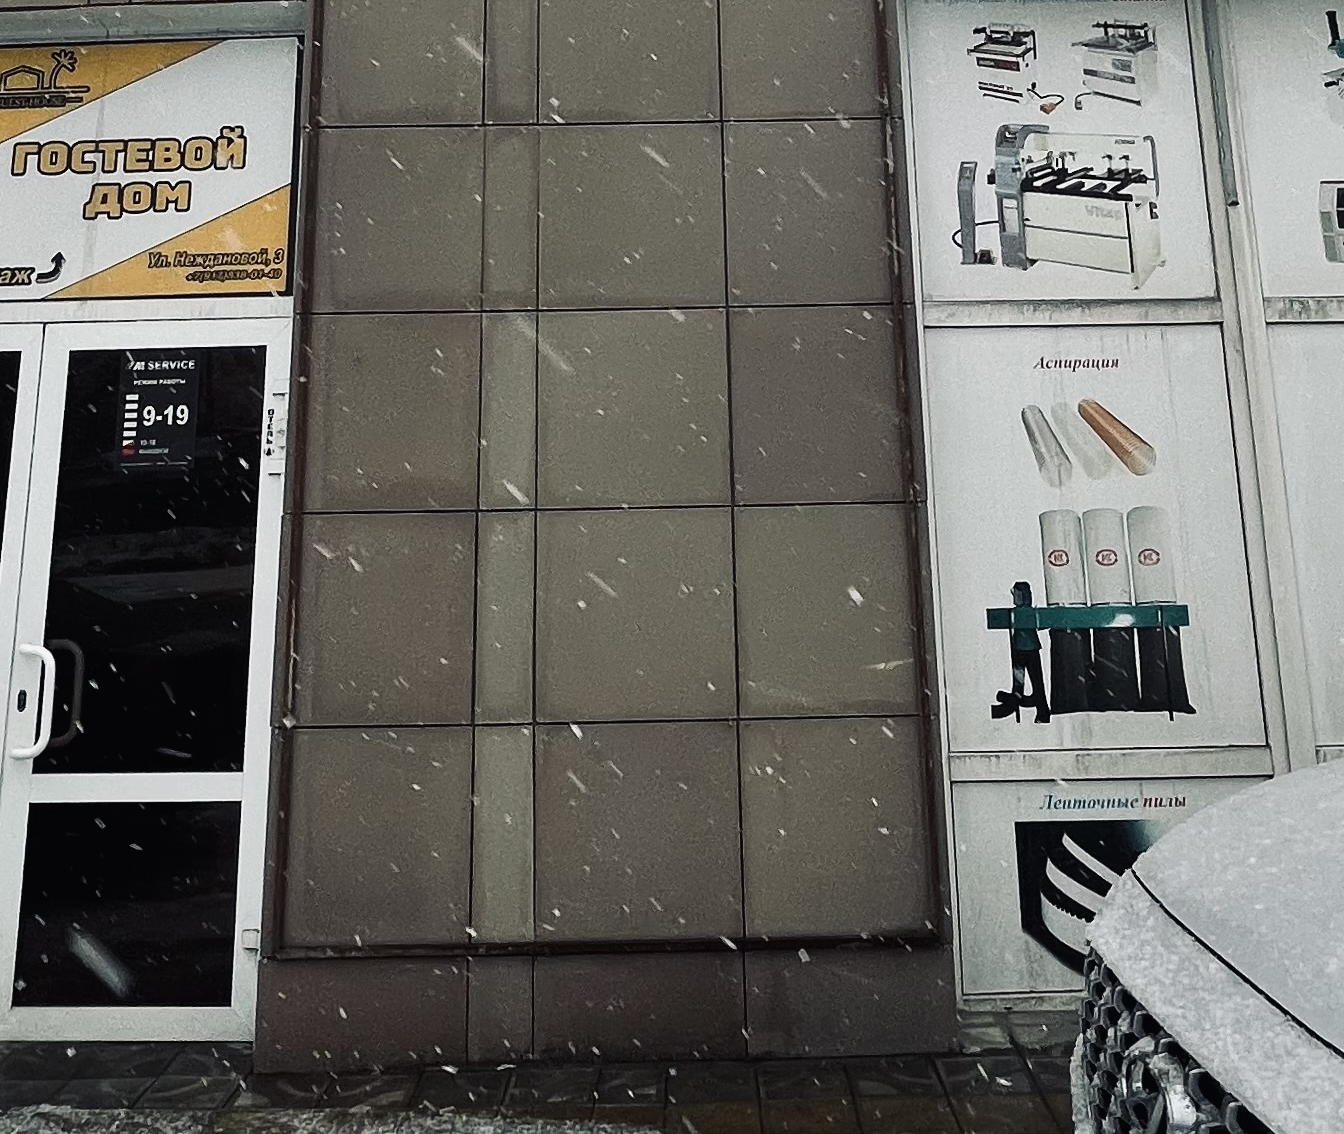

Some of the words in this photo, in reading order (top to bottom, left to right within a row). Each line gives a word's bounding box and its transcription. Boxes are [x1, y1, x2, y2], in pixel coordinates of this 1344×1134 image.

[11, 126, 246, 176] ГОСТЕВОЙ
[83, 181, 192, 220] ДОМ
[148, 252, 171, 268] Ул.
[173, 248, 271, 269] Неждановой,
[273, 248, 285, 264] 3
[147, 360, 195, 370] SERVICE
[1033, 356, 1119, 372] Аспирация
[142, 404, 189, 427] 9-19
[1039, 794, 1139, 809] Ленточные
[1143, 795, 1187, 808] пилы
